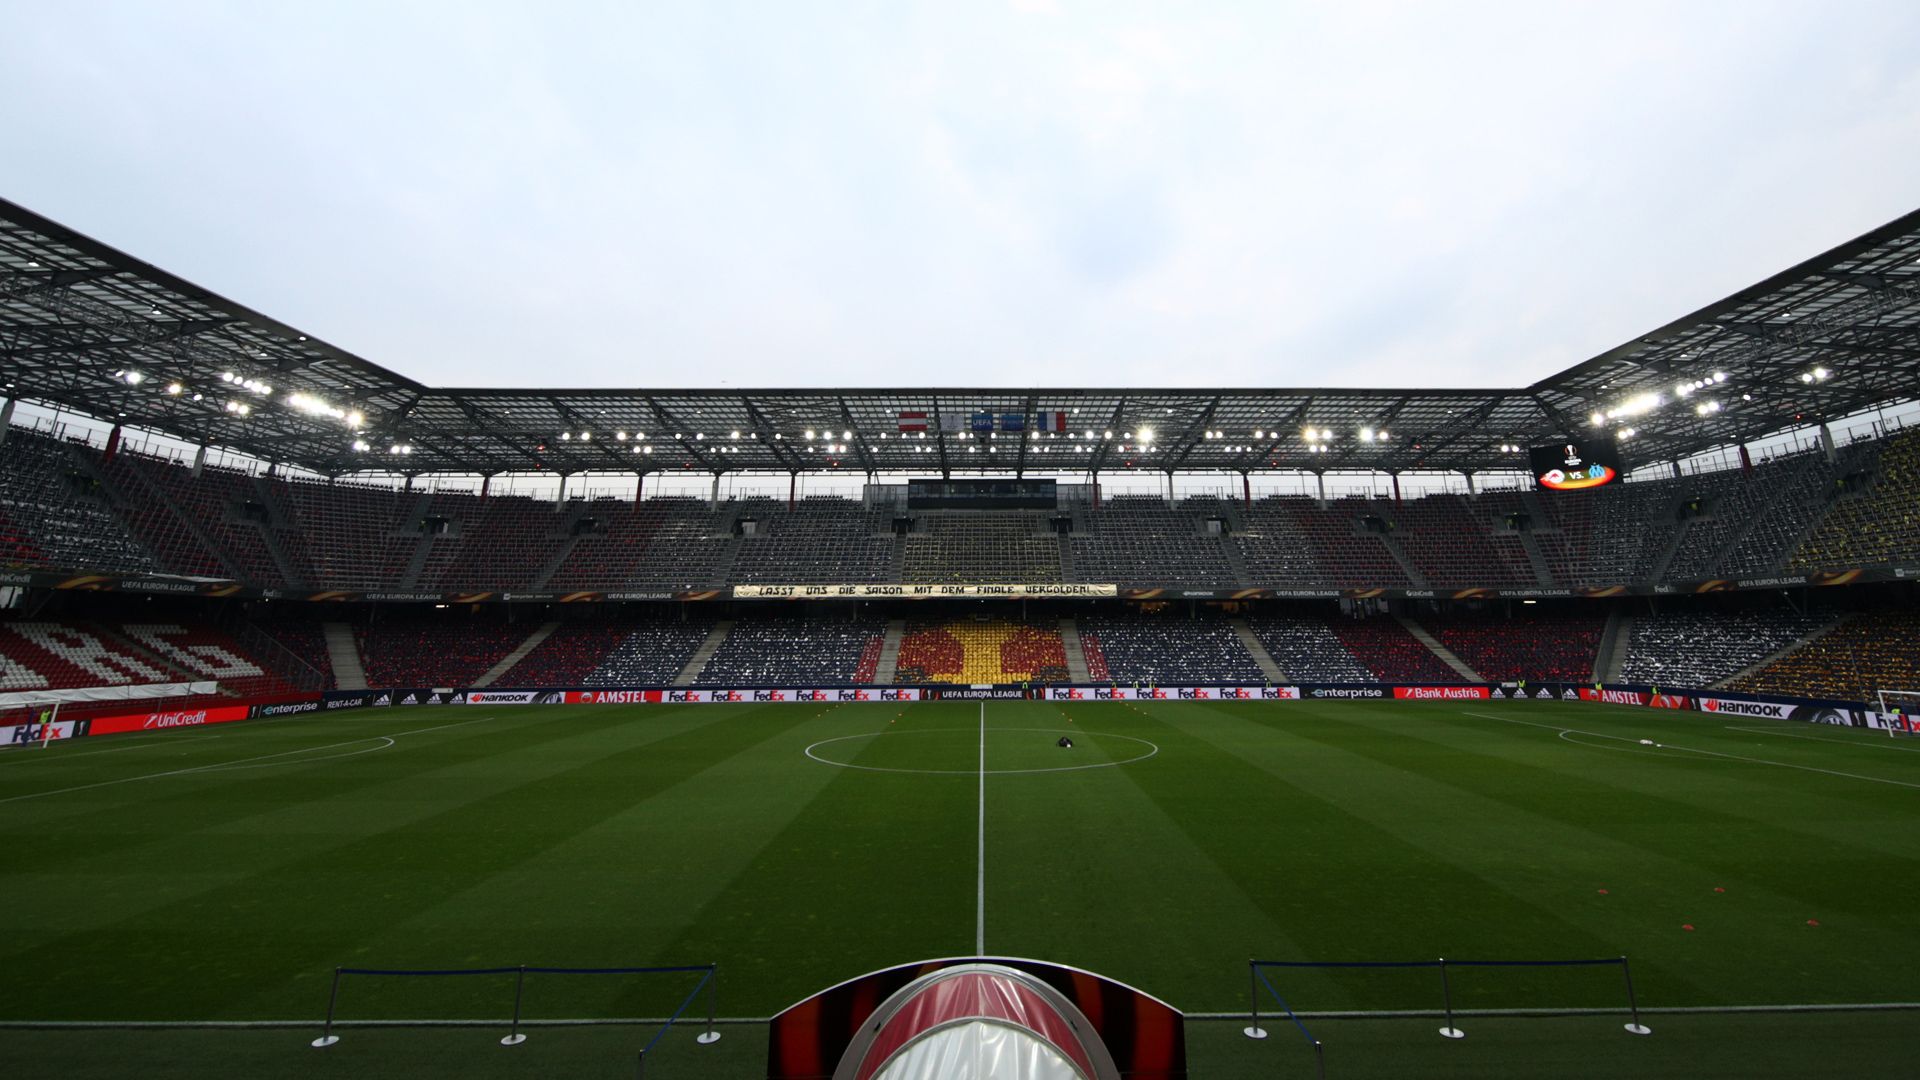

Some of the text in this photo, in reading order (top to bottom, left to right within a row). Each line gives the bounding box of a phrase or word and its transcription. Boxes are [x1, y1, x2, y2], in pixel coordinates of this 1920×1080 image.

[972, 419, 992, 427] UEFA
[121, 580, 197, 593] UEFA EUROPA LEAGUE
[1738, 576, 1808, 588] UEFA EUROPA LEAGUE
[366, 592, 386, 600] UEFA
[607, 592, 624, 600] UEFA
[647, 592, 673, 600] LEAGUE
[759, 586, 795, 596] LASST
[806, 586, 828, 595] UNS
[838, 586, 856, 595] DIE
[864, 586, 903, 595] SAISON
[913, 585, 933, 594] MIT
[941, 585, 965, 594] DEM
[976, 586, 1015, 595] FINALE
[1499, 589, 1571, 597] UEFA EUROPA LEAGUE
[595, 690, 648, 703] AMSTEL
[669, 691, 700, 702] FedEx
[711, 690, 743, 702] FedEx
[754, 689, 784, 701] FedEx
[796, 689, 827, 701] FedEx
[838, 689, 869, 701] FedEx
[880, 689, 911, 701] FedEx
[942, 690, 1023, 699] UEFA EUROPA LEAGUE
[1053, 688, 1083, 699] FedEx
[1095, 688, 1125, 699] FedEx
[1137, 688, 1167, 699] FedEx
[1178, 688, 1209, 699] FedEx
[1220, 688, 1250, 699] FedEx
[1261, 688, 1292, 699] FedEx
[1310, 687, 1383, 699] enterprise
[1414, 686, 1481, 699] Bank Austria
[1601, 690, 1644, 706] AMSTEL
[263, 700, 318, 716] enterprise
[326, 698, 363, 709] RENT-A-CAR
[157, 710, 207, 728] UniCredit
